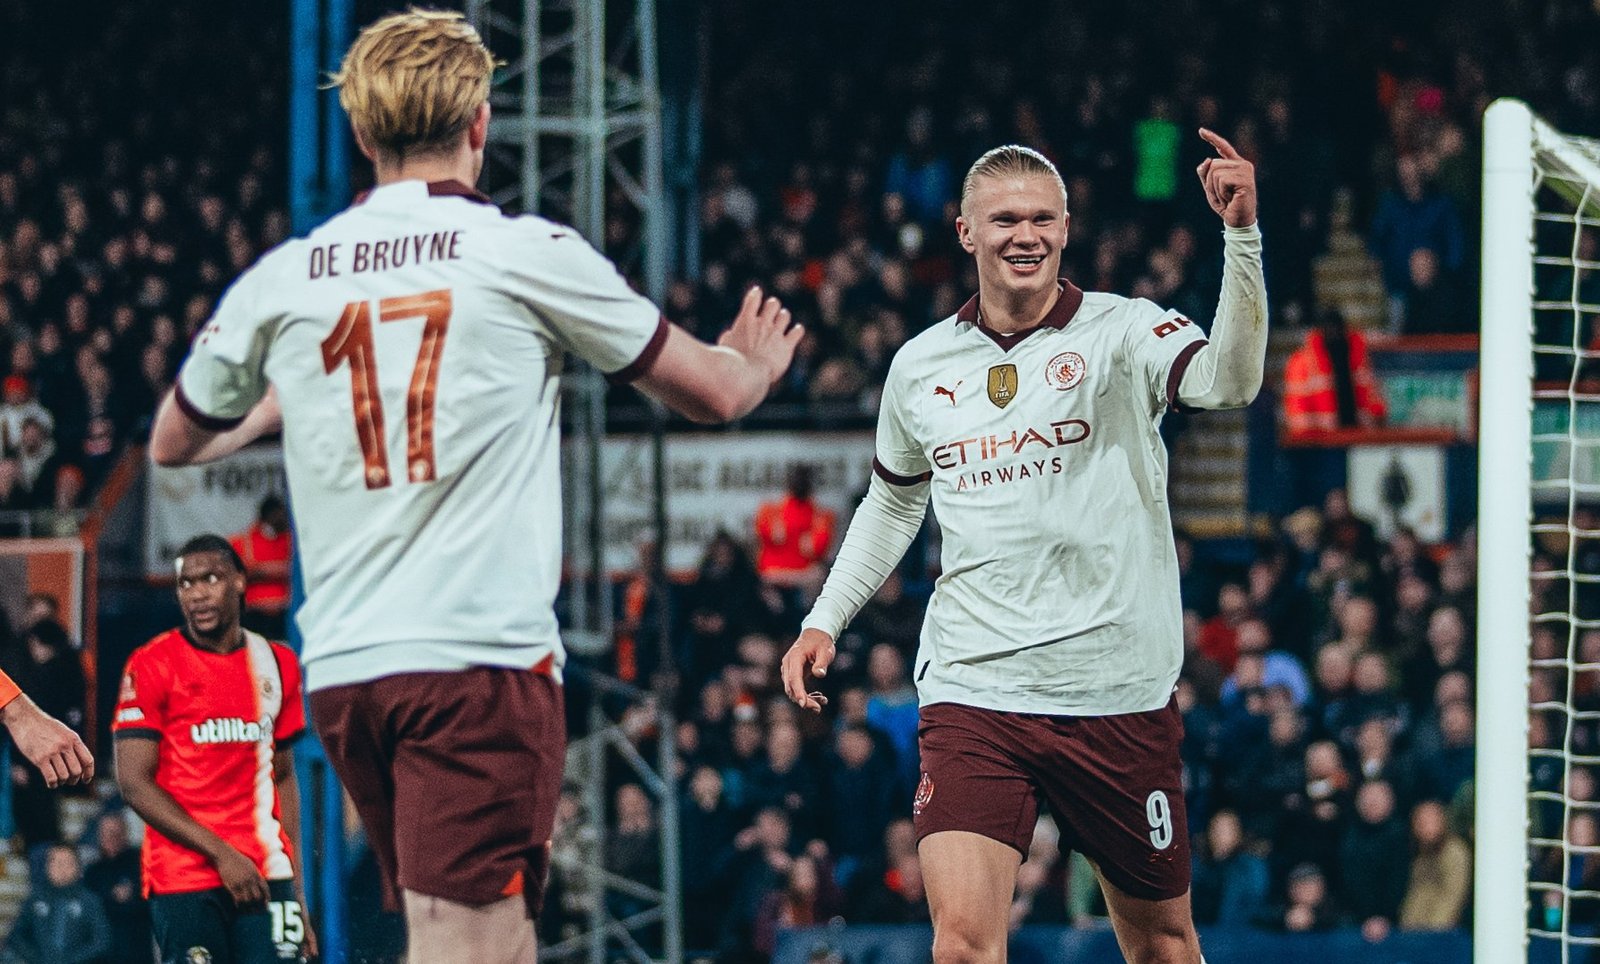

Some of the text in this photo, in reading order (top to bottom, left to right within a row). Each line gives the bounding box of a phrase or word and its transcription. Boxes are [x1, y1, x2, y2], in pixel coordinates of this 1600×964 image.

[310, 229, 466, 280] DE BRUYNE
[320, 289, 453, 490] 17
[932, 419, 1091, 470] ETIHAD
[957, 457, 1063, 491] AIRWAYS
[191, 717, 261, 744] utilita
[1146, 790, 1173, 850] 9
[268, 900, 305, 944] 15
